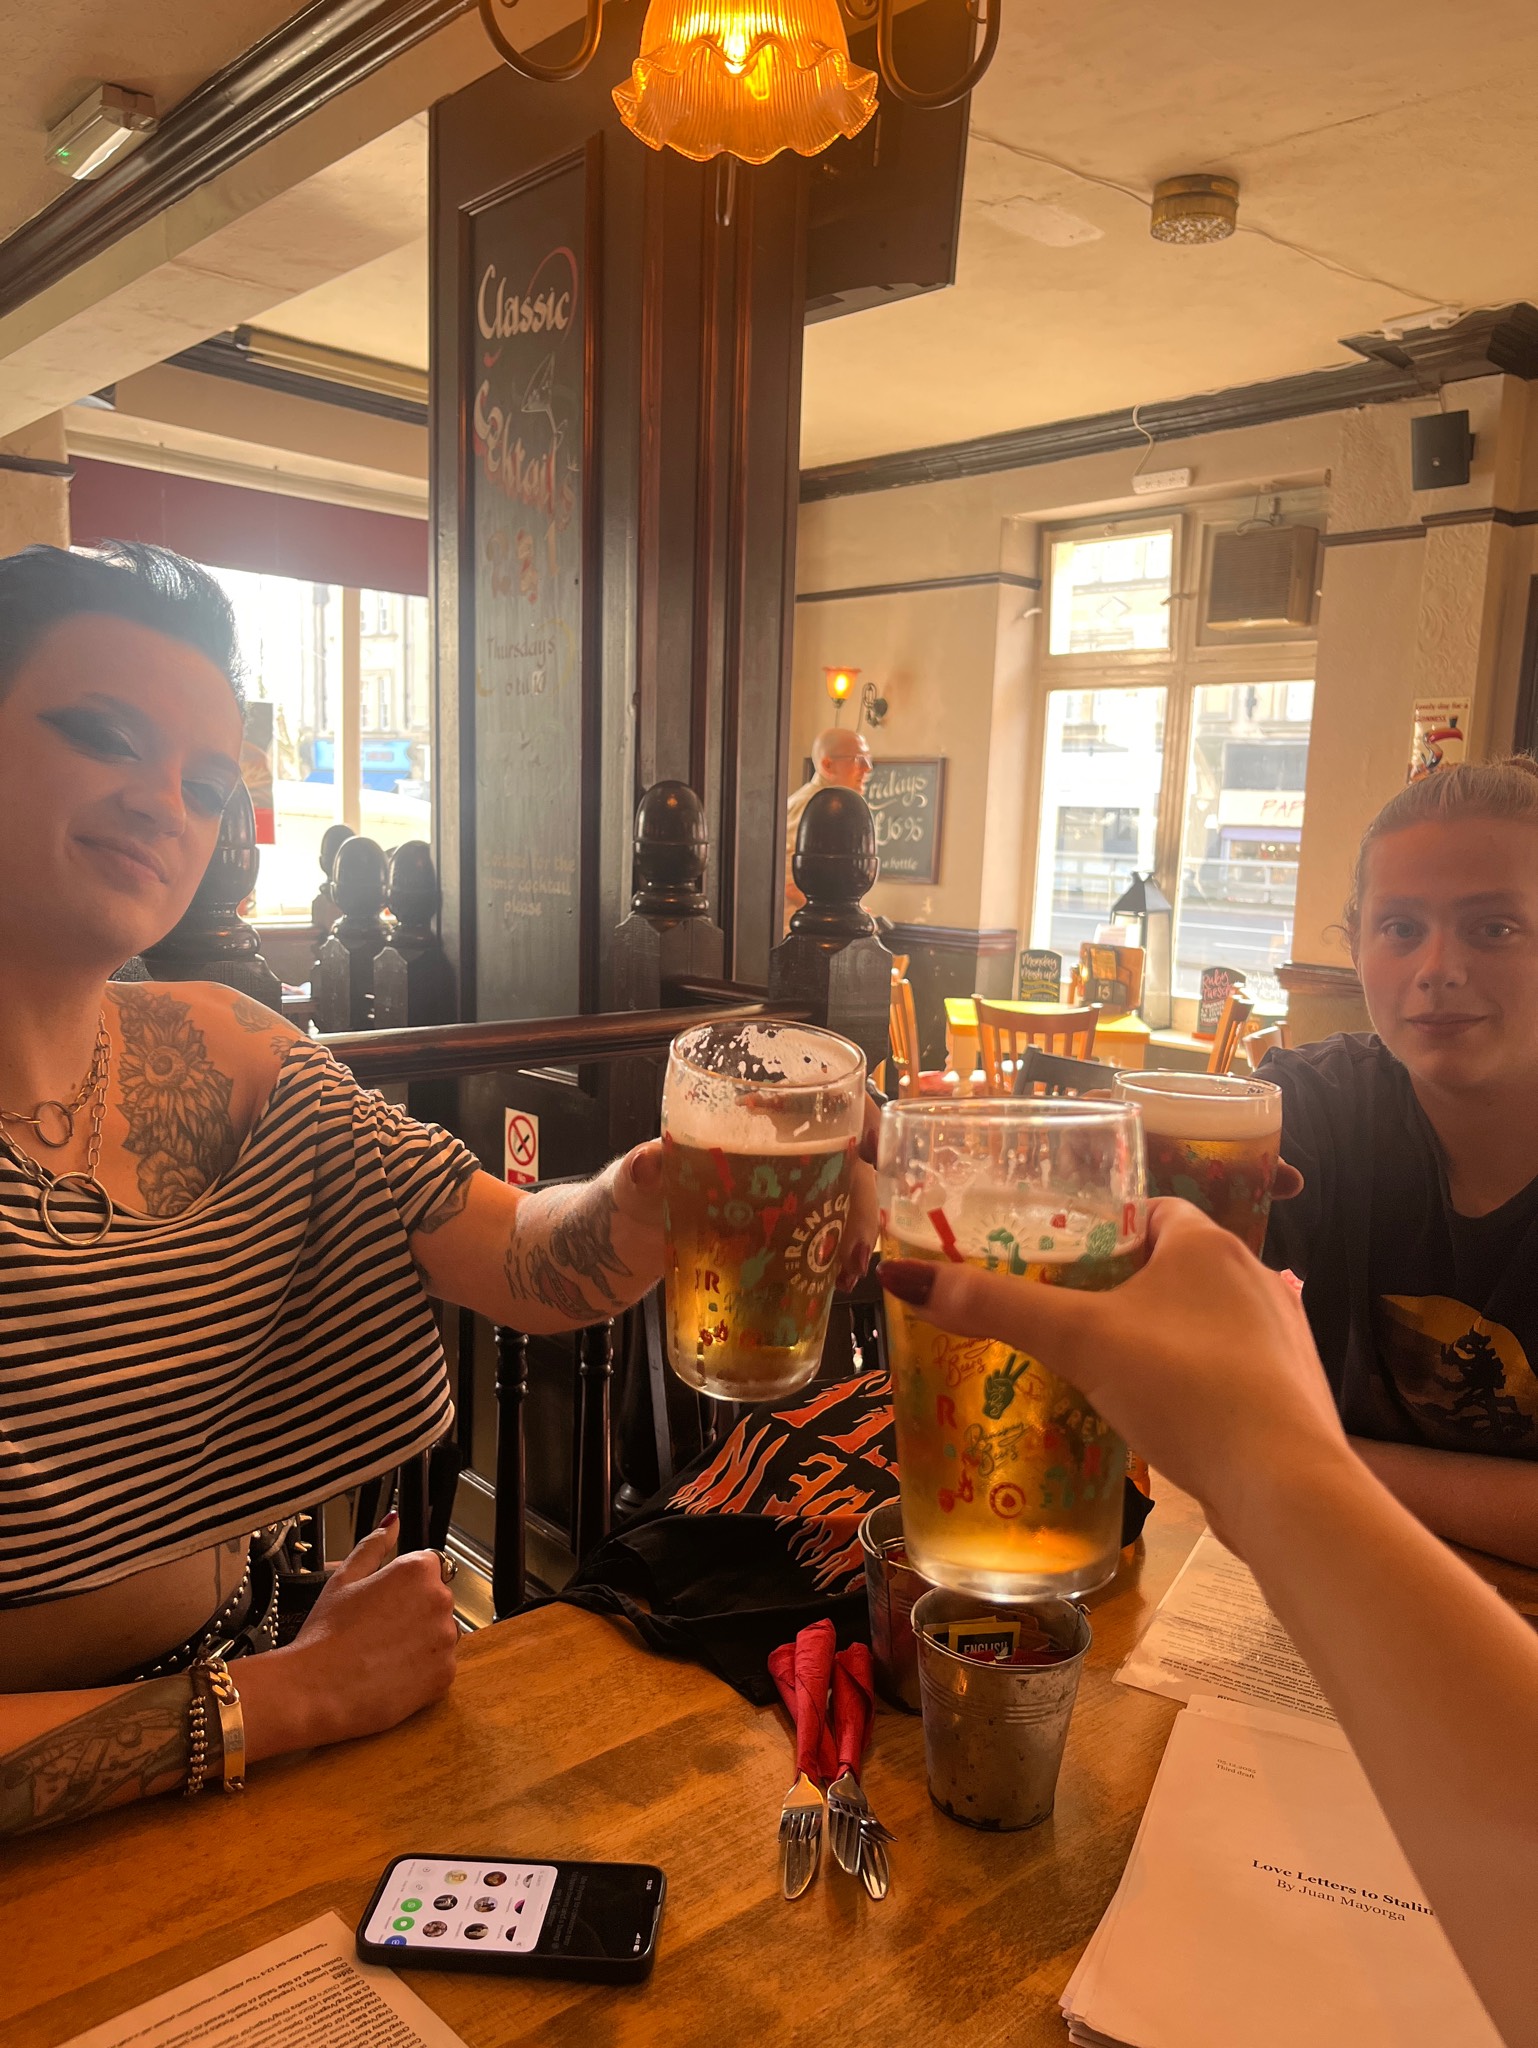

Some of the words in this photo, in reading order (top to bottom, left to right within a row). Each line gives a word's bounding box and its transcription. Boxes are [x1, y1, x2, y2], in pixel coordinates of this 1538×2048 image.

[477, 264, 569, 340] Classic
[487, 633, 556, 668] Thursdays
[868, 770, 927, 807] ridays
[1216, 1763, 1236, 1774] Third
[1236, 1769, 1255, 1779] draft
[1252, 1859, 1292, 1877] Love
[1297, 1871, 1357, 1895] Letters
[1361, 1887, 1379, 1900] to
[1382, 1894, 1434, 1916] Stalin
[1276, 1878, 1296, 1893] By
[1298, 1886, 1336, 1903] Juan
[1340, 1896, 1407, 1922] Mayorga
[332, 1966, 353, 1980] Sides
[345, 1990, 376, 2008] Meatball
[368, 2002, 387, 2014] Pasta
[350, 2013, 367, 2024] Bake
[372, 2014, 398, 2030] Creamy
